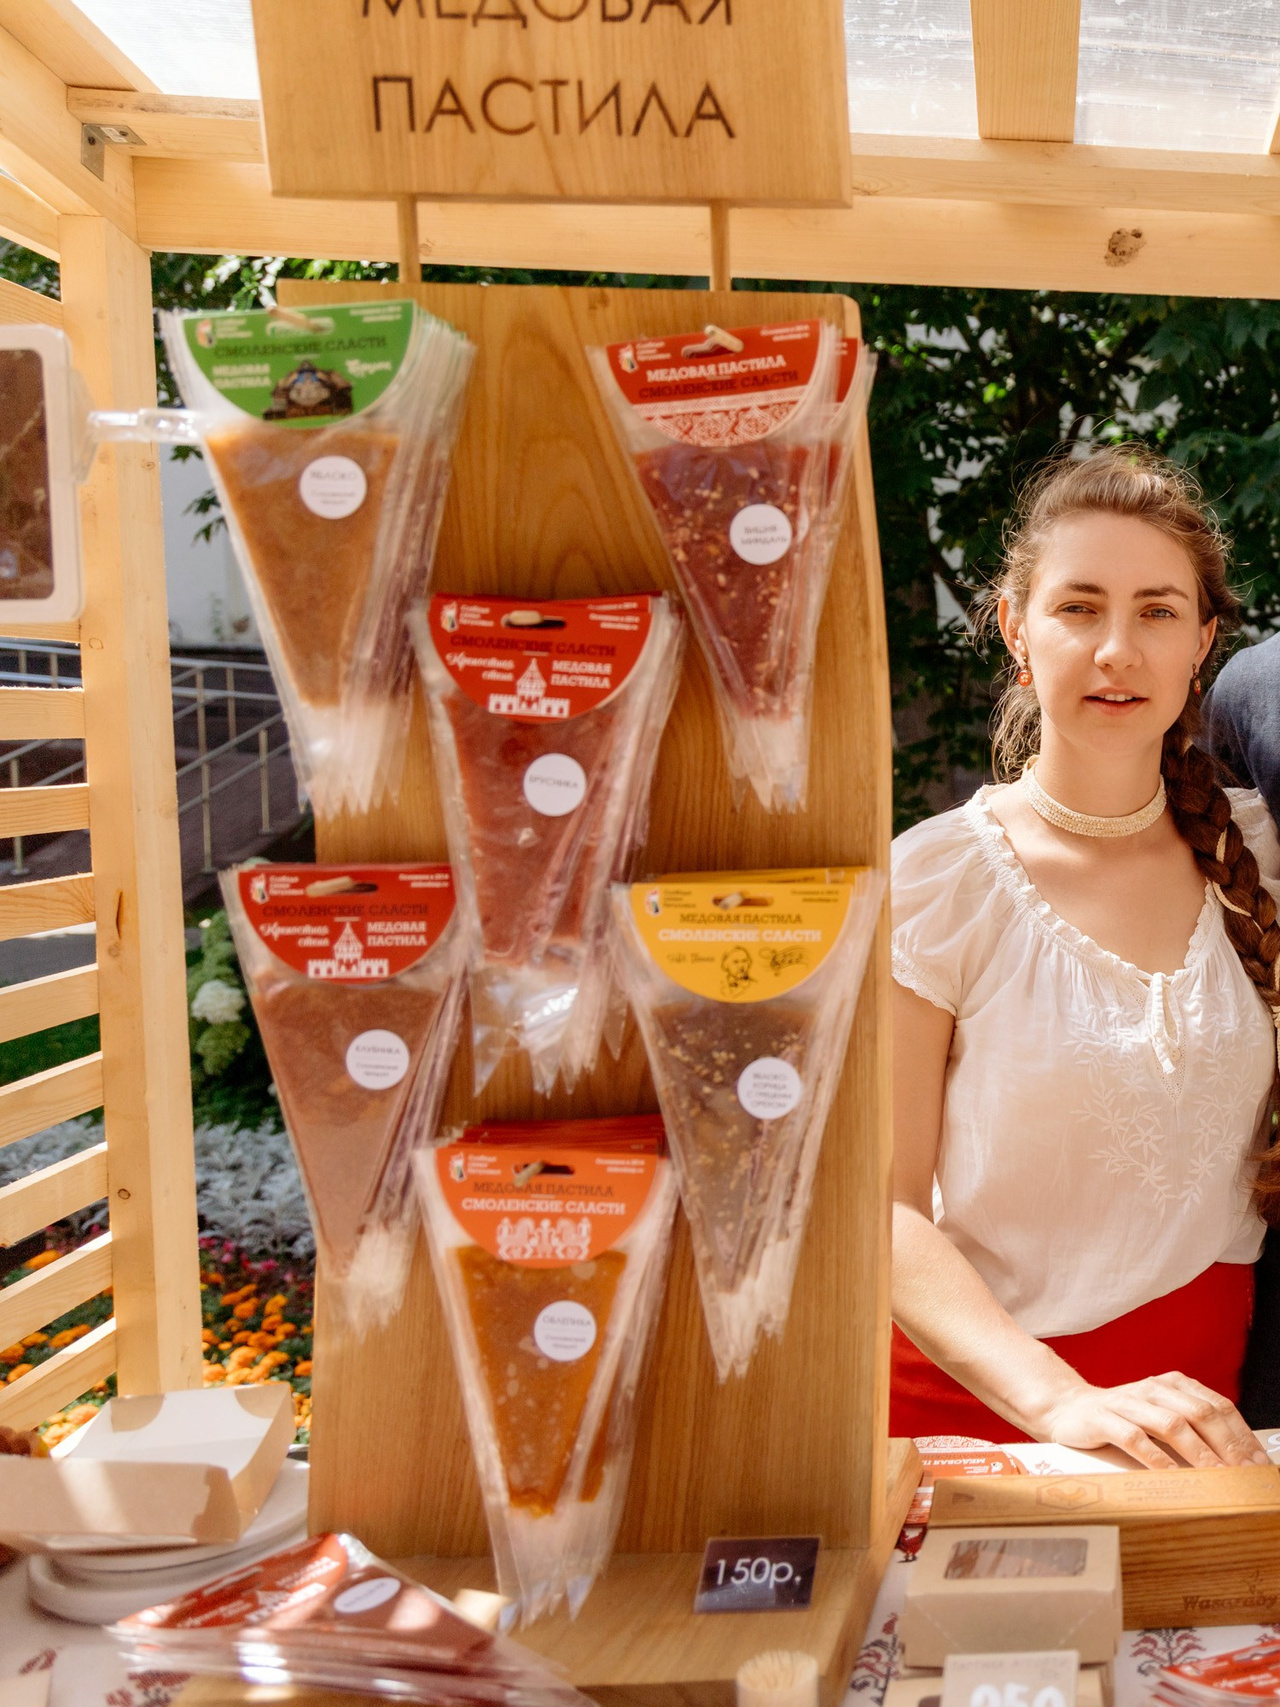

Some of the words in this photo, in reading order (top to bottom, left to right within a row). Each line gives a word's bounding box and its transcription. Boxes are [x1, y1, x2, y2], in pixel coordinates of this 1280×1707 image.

[372, 76, 737, 139] ПАСТИЛА
[324, 335, 388, 350] СЛАСТИ
[645, 361, 716, 383] МЕДОВАЯ
[717, 354, 787, 376] ПАСТИЛА
[637, 378, 738, 400] СМОЛЕНСКИЕ
[739, 369, 799, 388] СЛАСТИ
[449, 633, 554, 653] СМОЛЕНСКИЕ
[555, 642, 617, 658] СЛАСТИ
[551, 659, 613, 676] МЕДОВАЯ
[550, 673, 611, 690] ПАСТИЛА
[262, 904, 365, 918] СМОЛЕНСКИЕ
[368, 903, 429, 916] СЛАСТИ
[679, 913, 742, 925] МЕДОВАЯ
[743, 913, 802, 925] ПАСТИЛА
[366, 921, 427, 934] МЕДОВАЯ
[657, 928, 760, 943] СМОЛЕНСКИЕ
[761, 928, 823, 943] СЛАСТИ
[366, 934, 428, 948] ПАСТИЛА
[473, 1181, 542, 1195] МЕДОВАЯ
[545, 1183, 614, 1198] ПАСТИЛА
[461, 1197, 564, 1214] СМОЛЕНСКИЕ
[565, 1199, 626, 1216] СЛАСТИ
[716, 1556, 802, 1590] 150р.
